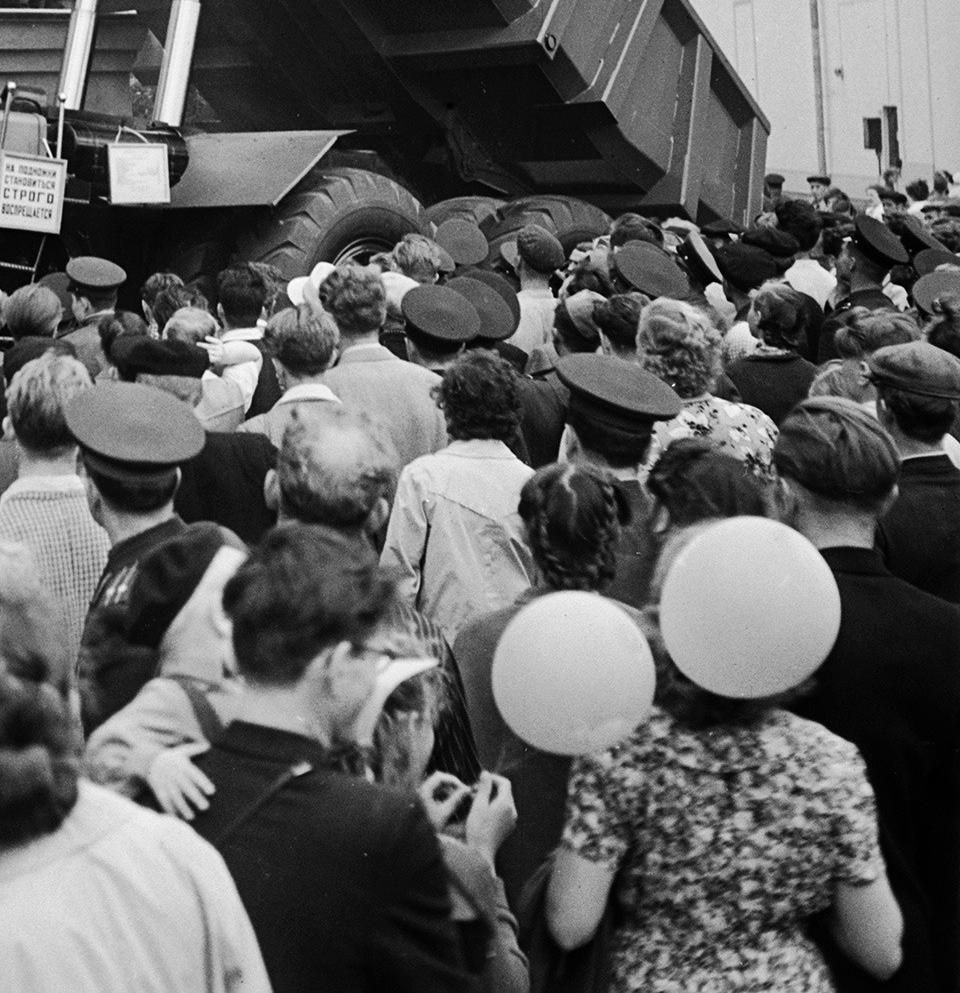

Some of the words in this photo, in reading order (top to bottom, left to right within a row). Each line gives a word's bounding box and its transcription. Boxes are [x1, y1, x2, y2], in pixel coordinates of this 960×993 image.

[6, 164, 15, 172] НА
[4, 175, 56, 190] СТАНОВИТЬСЯ
[3, 187, 55, 204] СТРОГО
[1, 203, 53, 220] ВОСПРЕЩАЕТСЯ
